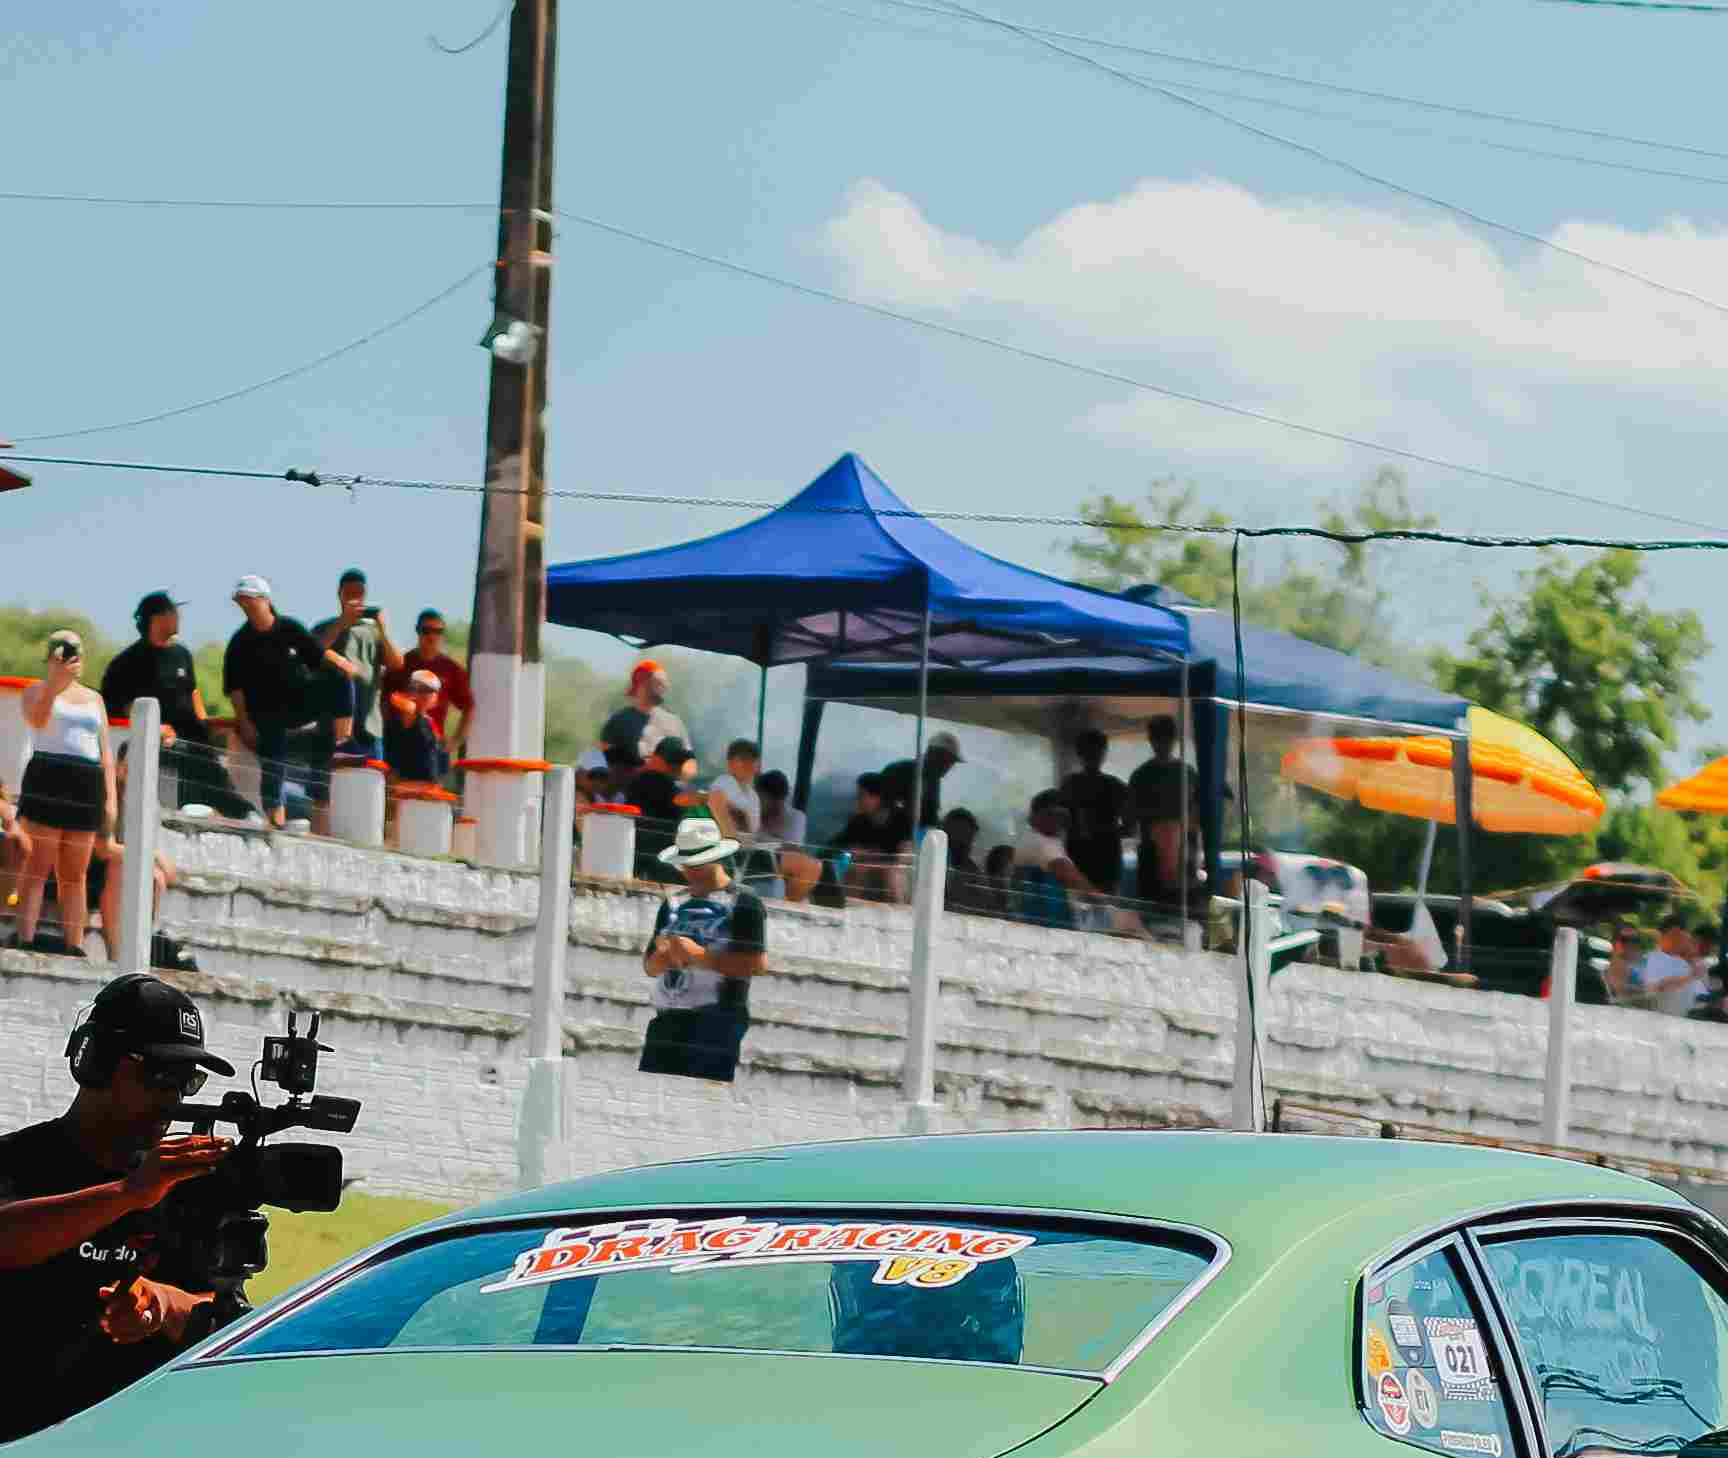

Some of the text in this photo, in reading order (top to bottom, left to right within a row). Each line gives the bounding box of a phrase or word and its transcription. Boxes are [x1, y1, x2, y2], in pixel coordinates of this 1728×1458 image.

[534, 1225, 1026, 1274] DRAG RACING
[884, 1256, 974, 1284] V8
[1445, 1345, 1478, 1375] 021
